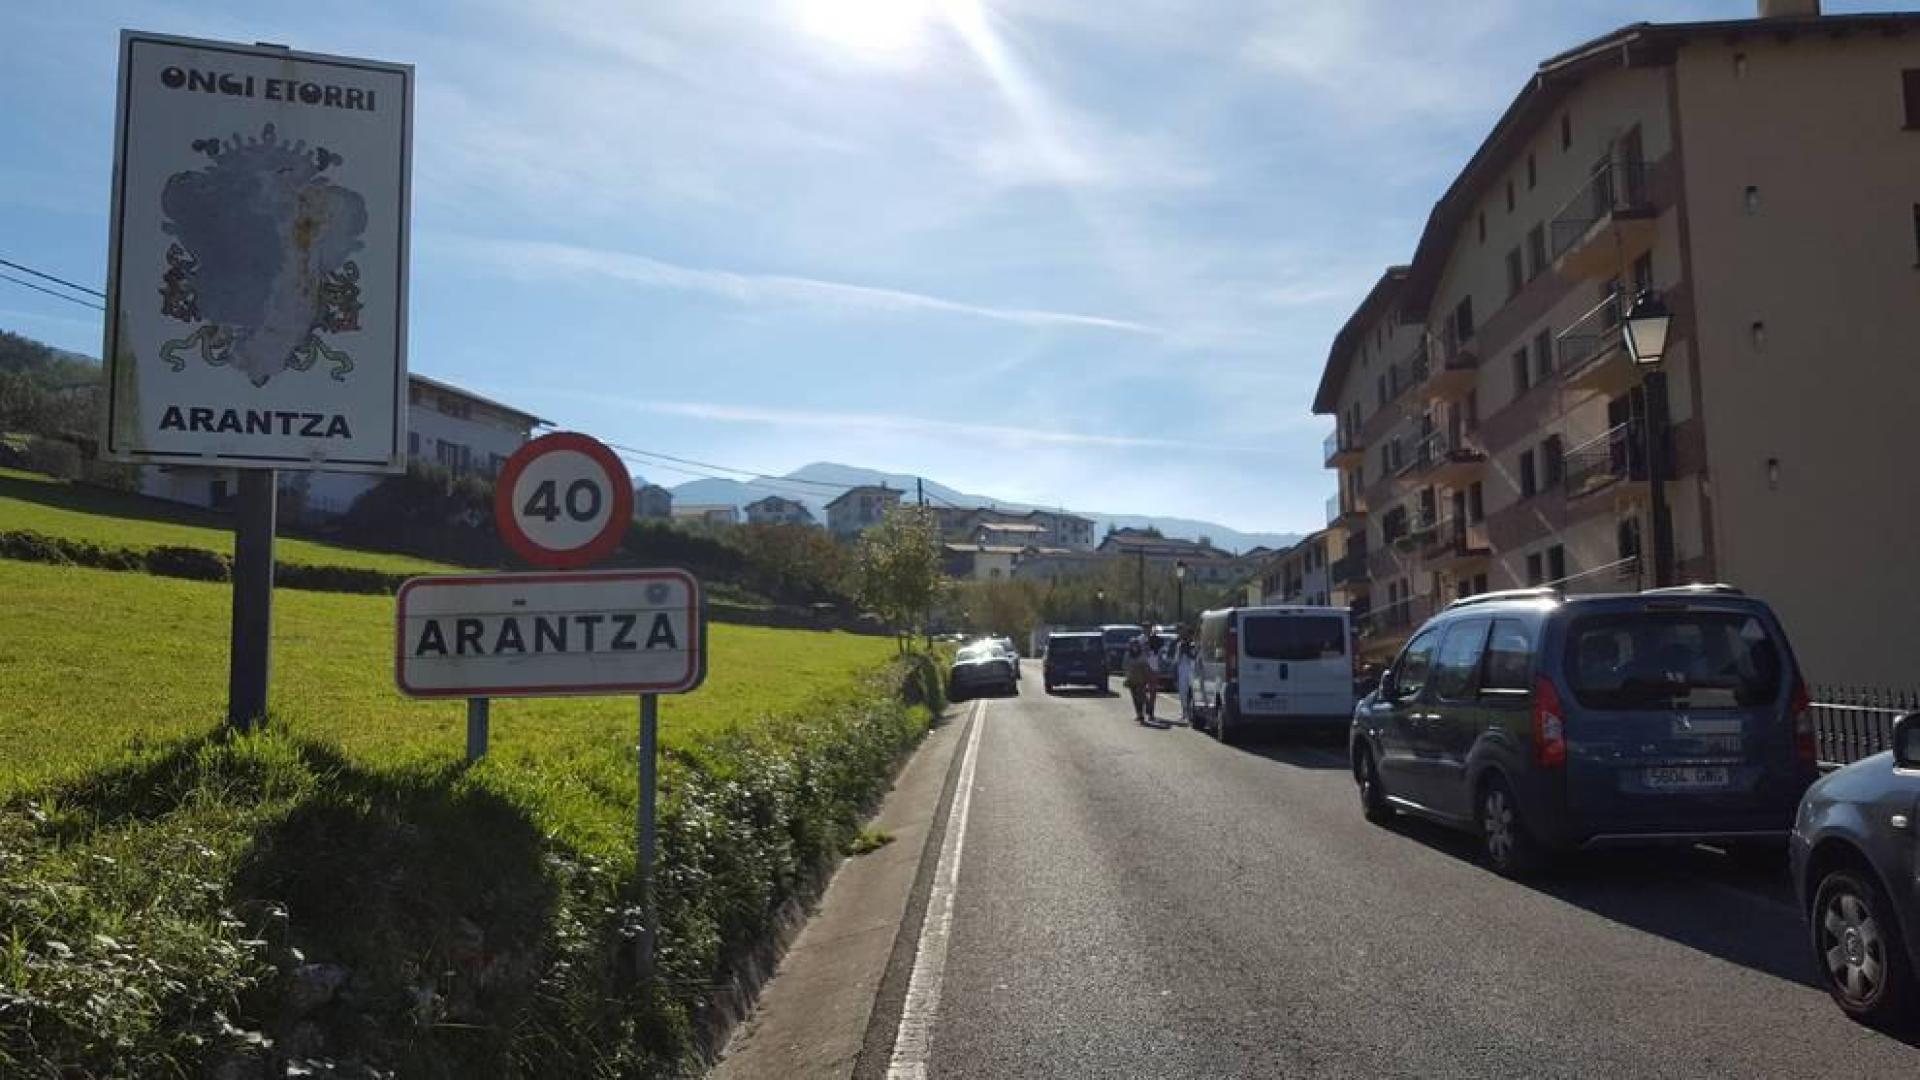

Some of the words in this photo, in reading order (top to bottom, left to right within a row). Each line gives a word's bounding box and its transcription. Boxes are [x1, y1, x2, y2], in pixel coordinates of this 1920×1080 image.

[161, 66, 254, 96] ONGI
[265, 79, 376, 111] ETORRI
[159, 405, 352, 439] ARANTZA
[523, 478, 601, 522] 40
[416, 612, 677, 656] ARANTZA
